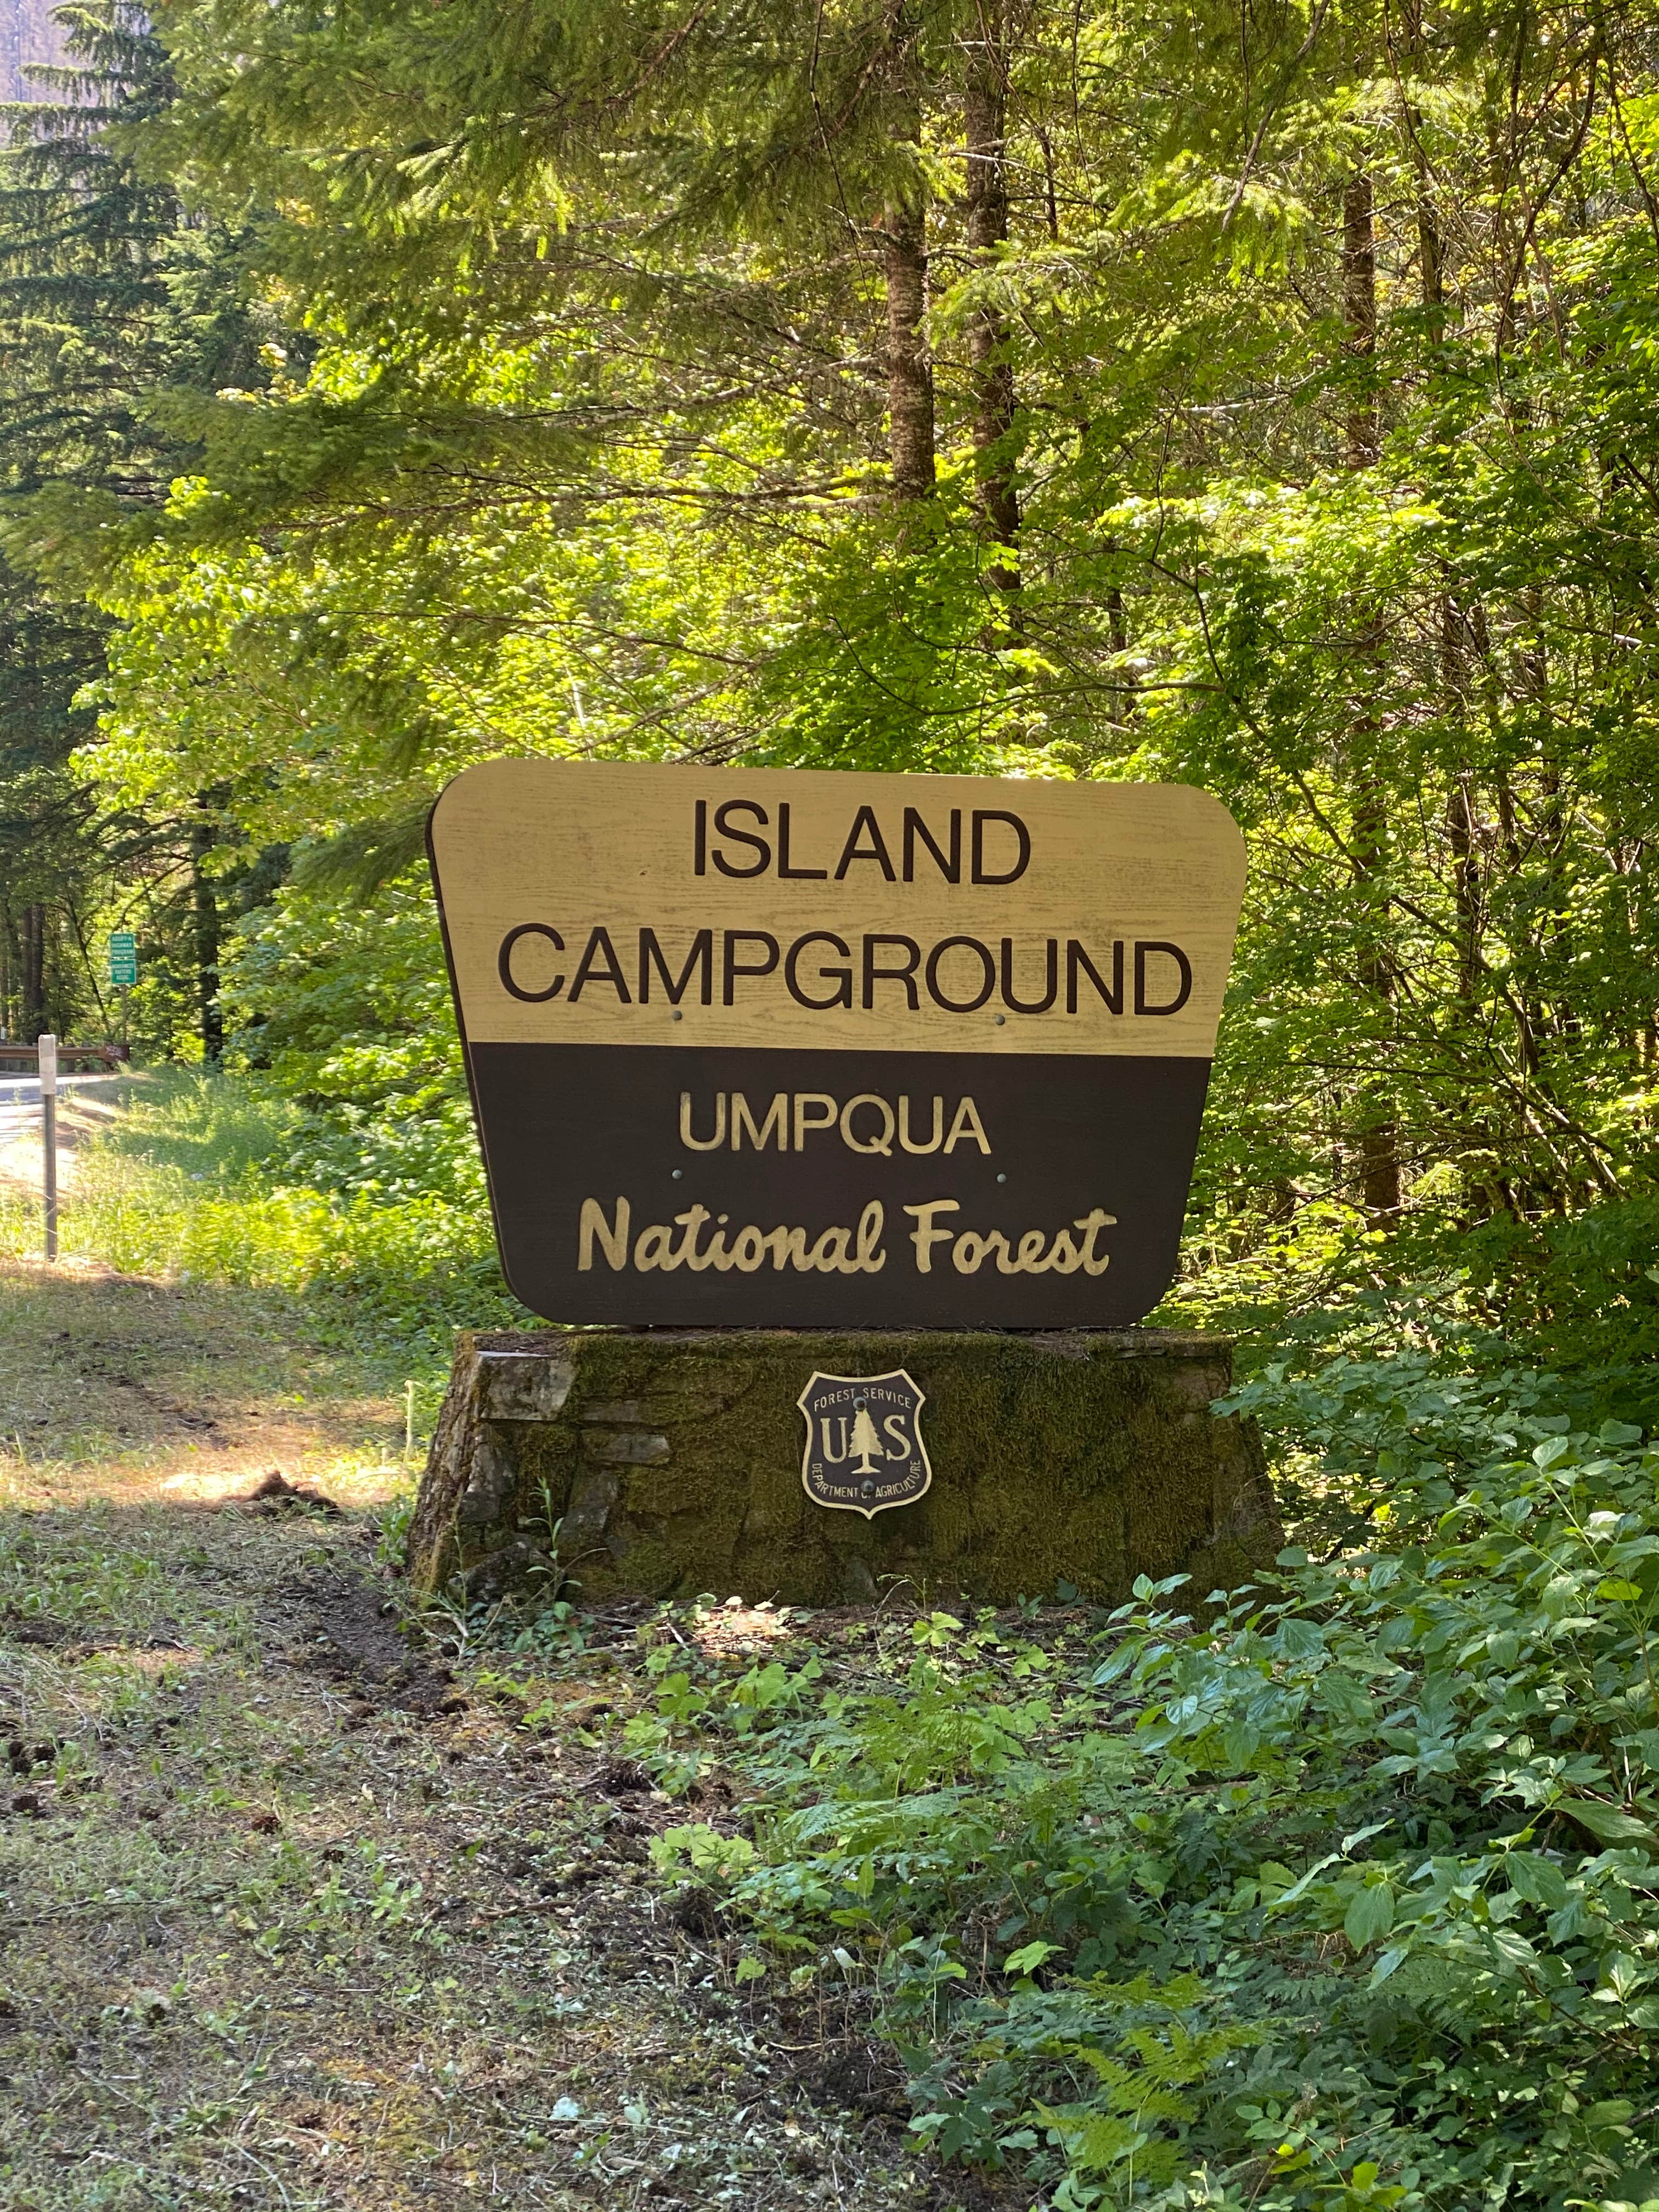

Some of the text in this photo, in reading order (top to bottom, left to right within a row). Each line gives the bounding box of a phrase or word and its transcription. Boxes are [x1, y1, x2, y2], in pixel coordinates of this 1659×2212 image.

[694, 799, 1031, 885] ISLAND
[498, 922, 1193, 1016] CAMPGROUND
[679, 1091, 992, 1156] UMPQUA
[577, 1195, 1118, 1276] National Forest
[814, 1387, 911, 1412] FOREST SERVICE
[820, 1414, 911, 1463] U S
[811, 1463, 858, 1498] DEPARTMENT
[874, 1459, 921, 1498] AGRICULTURE
